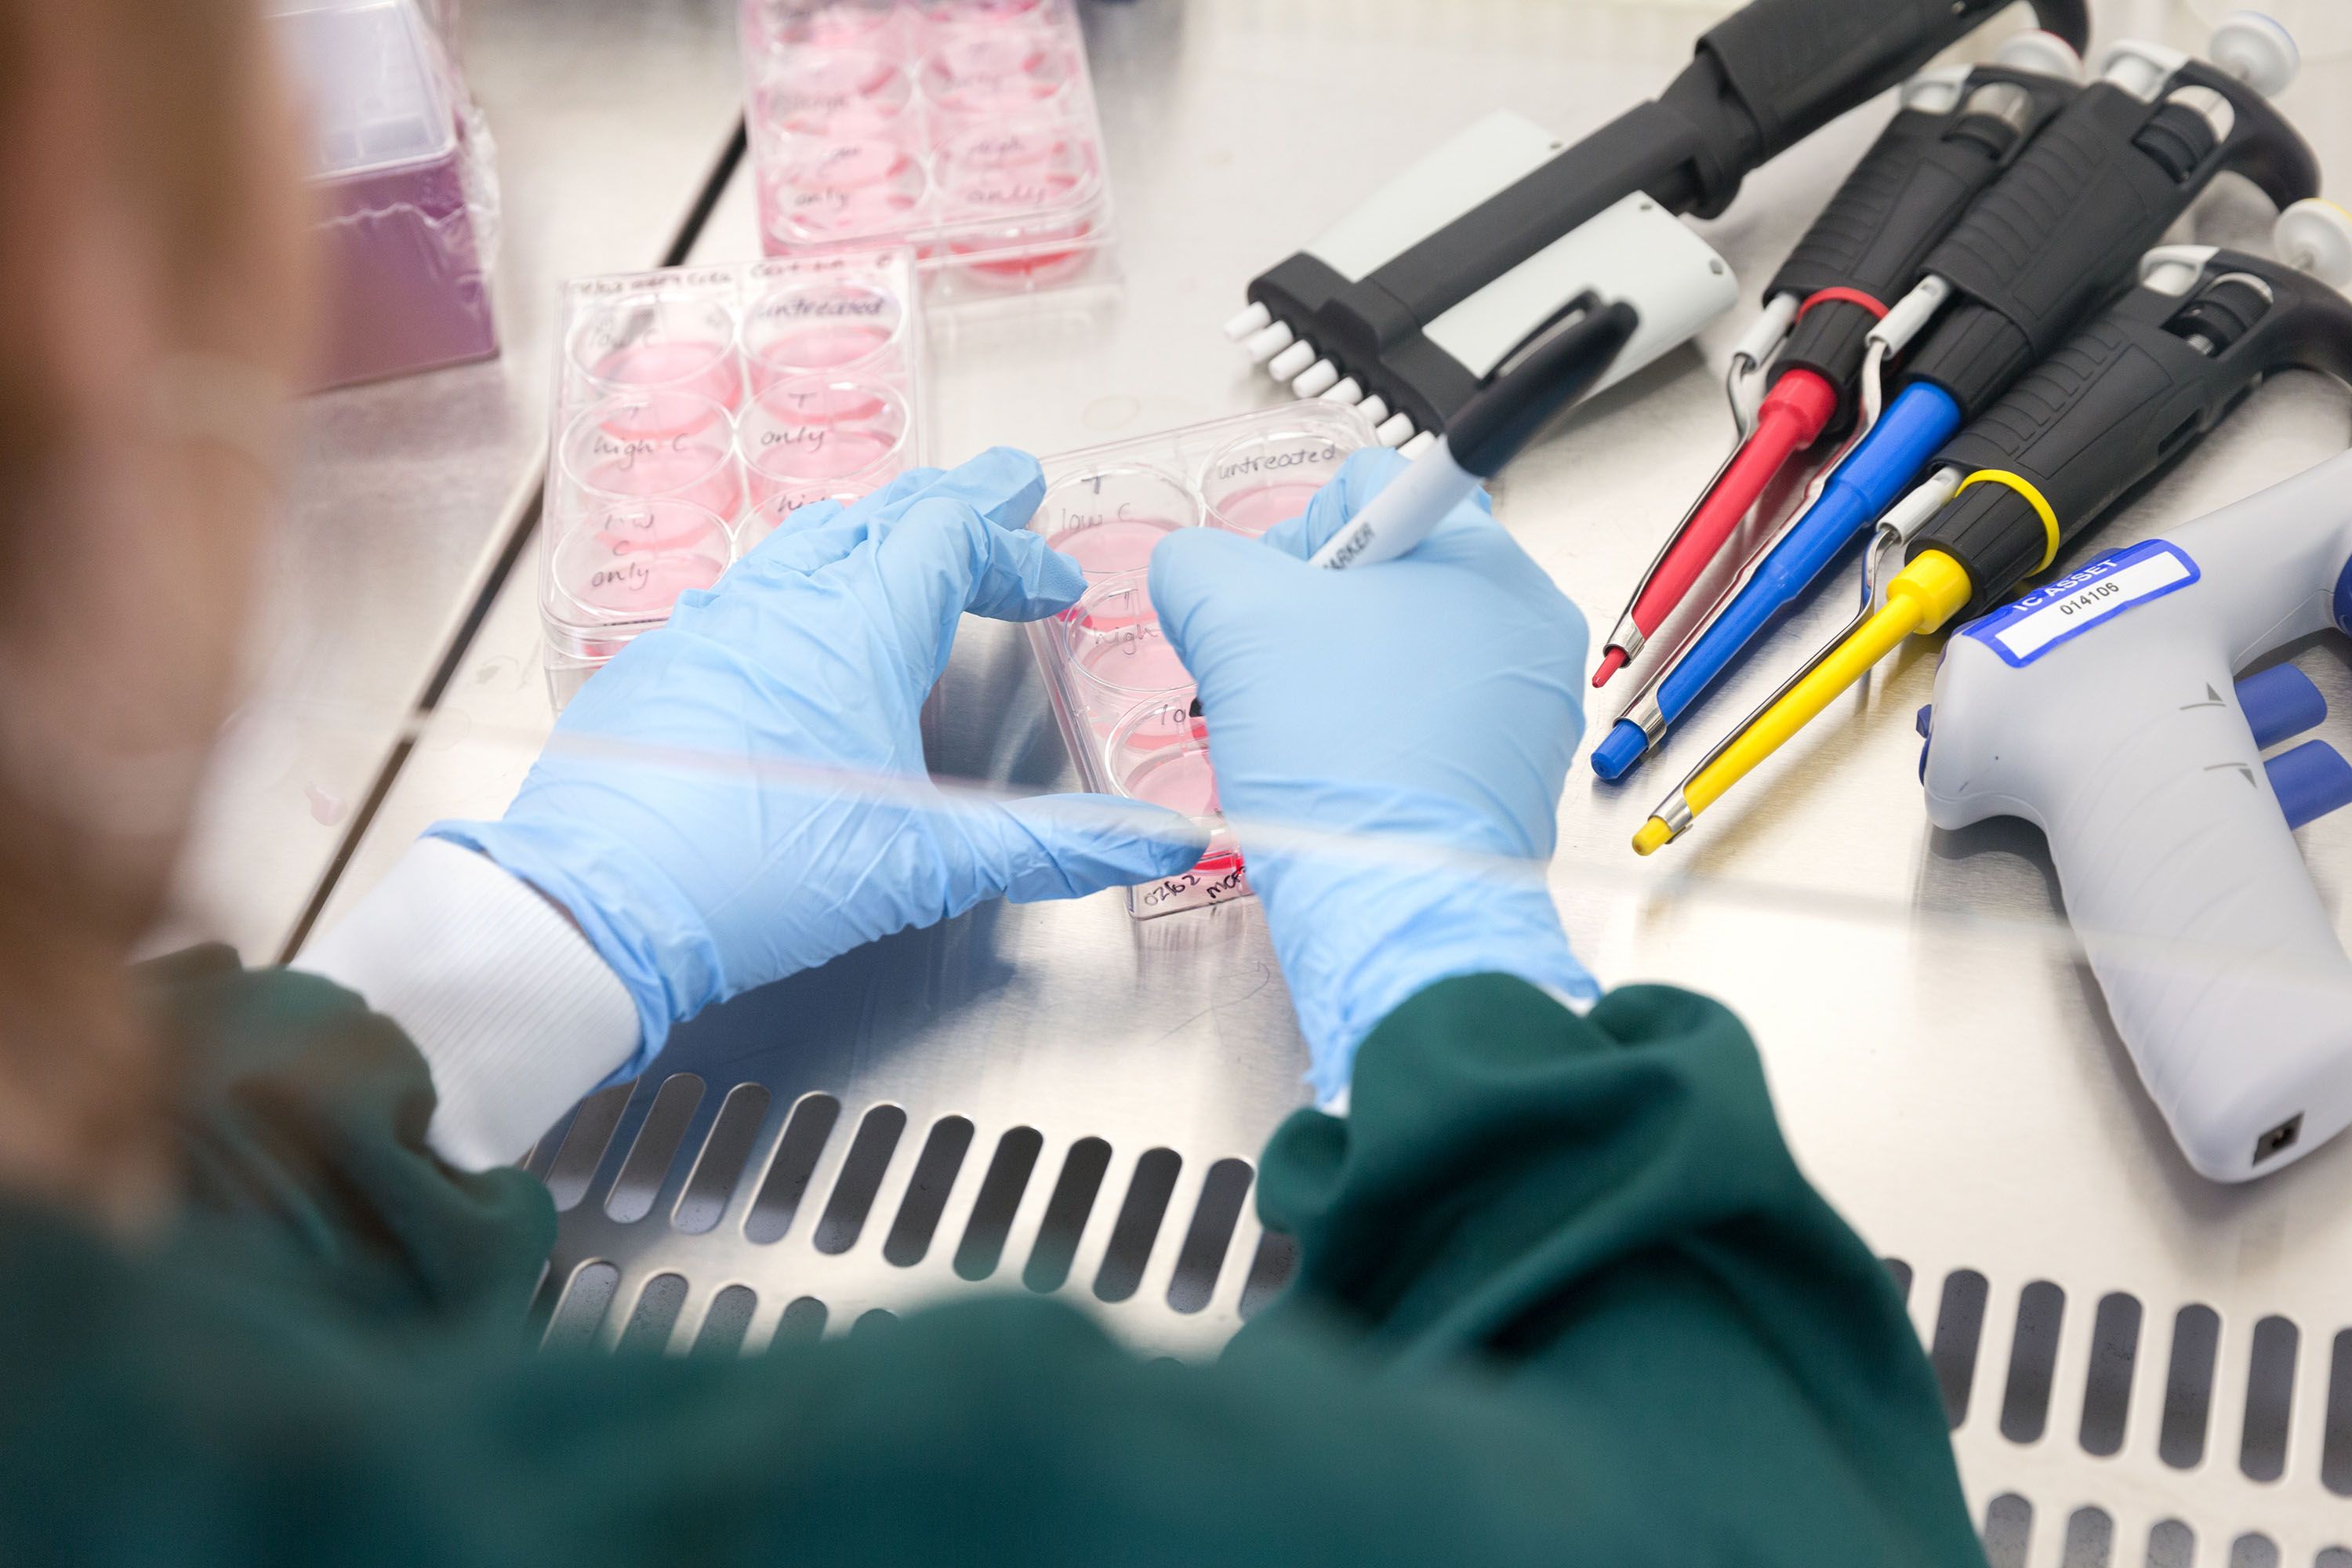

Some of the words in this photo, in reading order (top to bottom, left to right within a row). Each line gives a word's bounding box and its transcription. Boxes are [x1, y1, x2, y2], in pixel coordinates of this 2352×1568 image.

[788, 392, 818, 408] T
[593, 434, 653, 471] high
[672, 433, 689, 452] C
[760, 425, 825, 453] only
[1218, 444, 1336, 480] untreated
[778, 493, 826, 514] hi
[1062, 508, 1103, 531] low
[1117, 503, 1131, 522] C
[612, 540, 630, 557] C
[1323, 521, 1376, 569] ARKER
[591, 562, 649, 592] only
[2012, 596, 2043, 612] IC
[2044, 558, 2119, 597] ASSET
[2060, 582, 2120, 615] 014106
[1093, 623, 1158, 655] high
